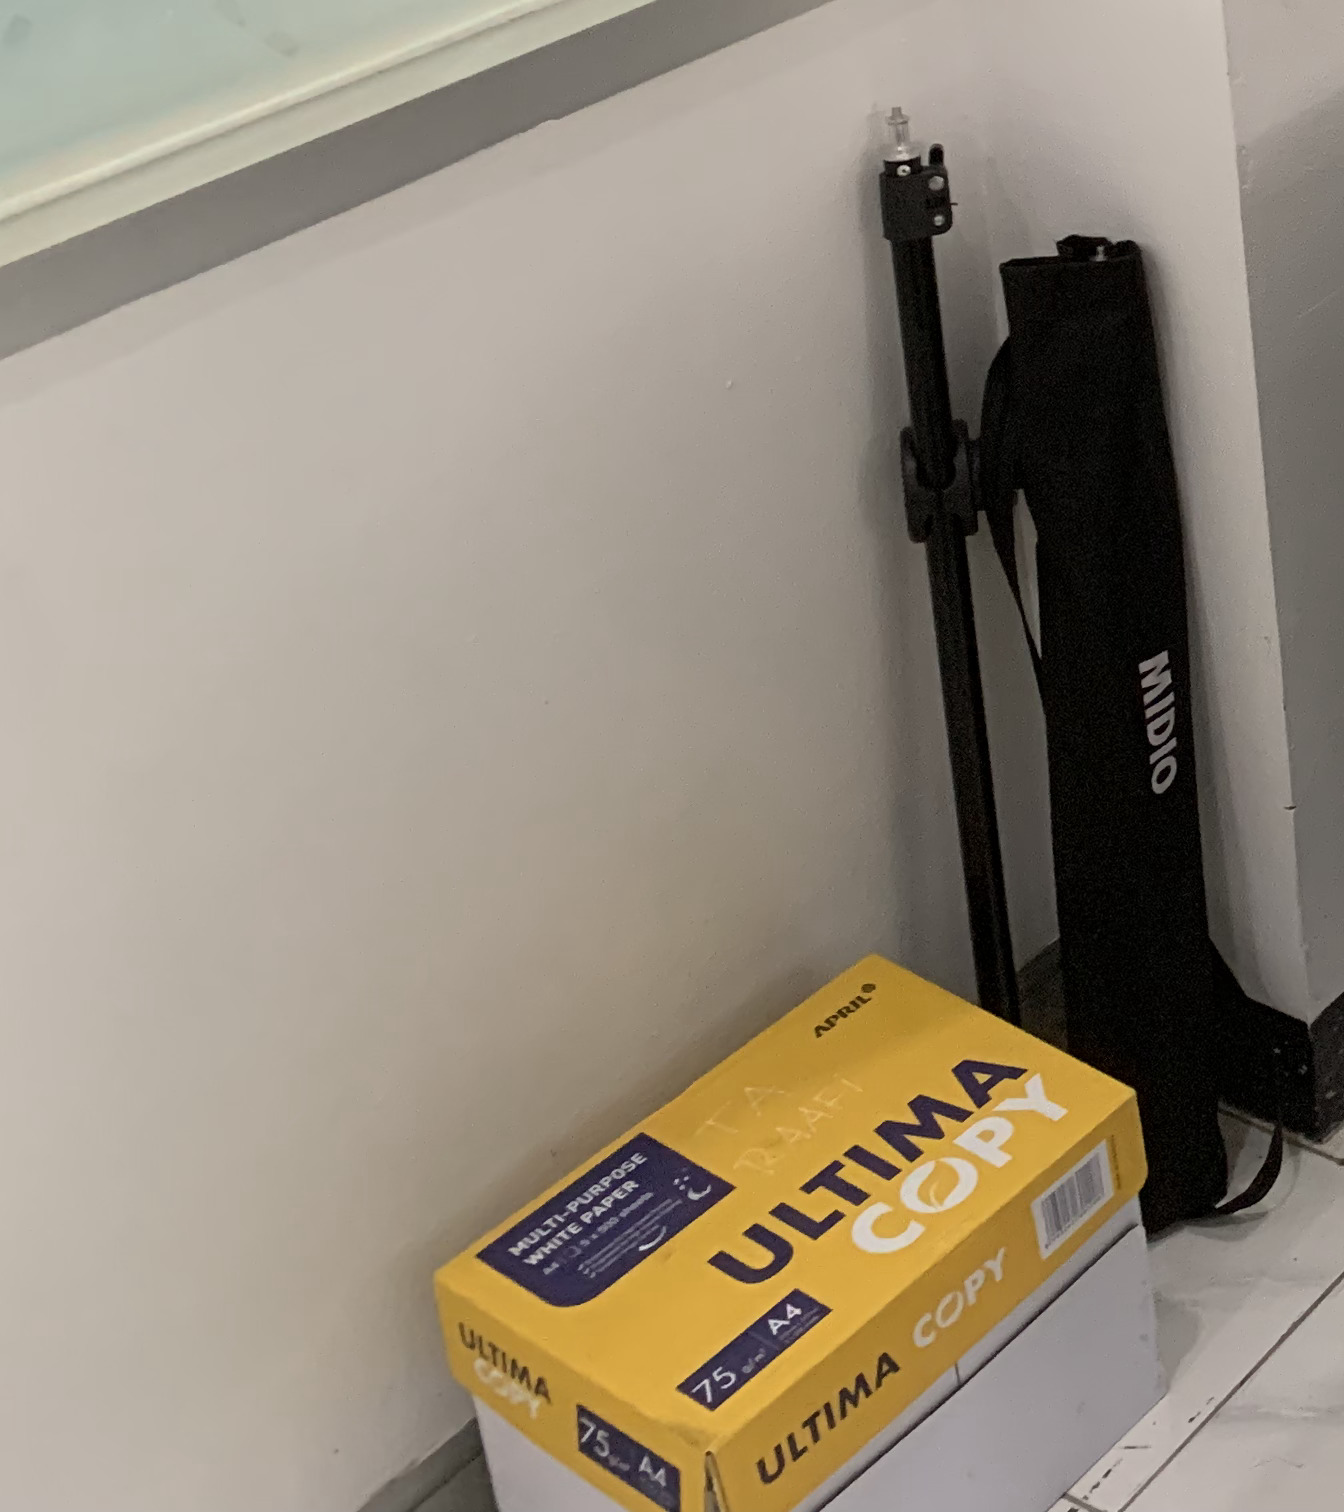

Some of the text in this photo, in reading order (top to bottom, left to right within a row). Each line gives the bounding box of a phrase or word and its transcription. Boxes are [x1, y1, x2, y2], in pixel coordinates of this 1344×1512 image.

[1138, 650, 1177, 794] MIDIO
[813, 995, 872, 1038] APRIL
[507, 1152, 648, 1257] MULTI-PURPOSE
[707, 1059, 1028, 1284] ULTIMA
[851, 1073, 1069, 1254] COPY
[523, 1221, 584, 1265] WHITE
[580, 1179, 640, 1225] PAPER
[459, 1321, 552, 1405] ULTIMA
[473, 1357, 542, 1420] COPY
[691, 1365, 737, 1403] 75
[767, 1303, 802, 1336] A4
[755, 1247, 1006, 1486] ULTIMA COPY
[578, 1416, 610, 1458] 75
[638, 1455, 667, 1488] A4
